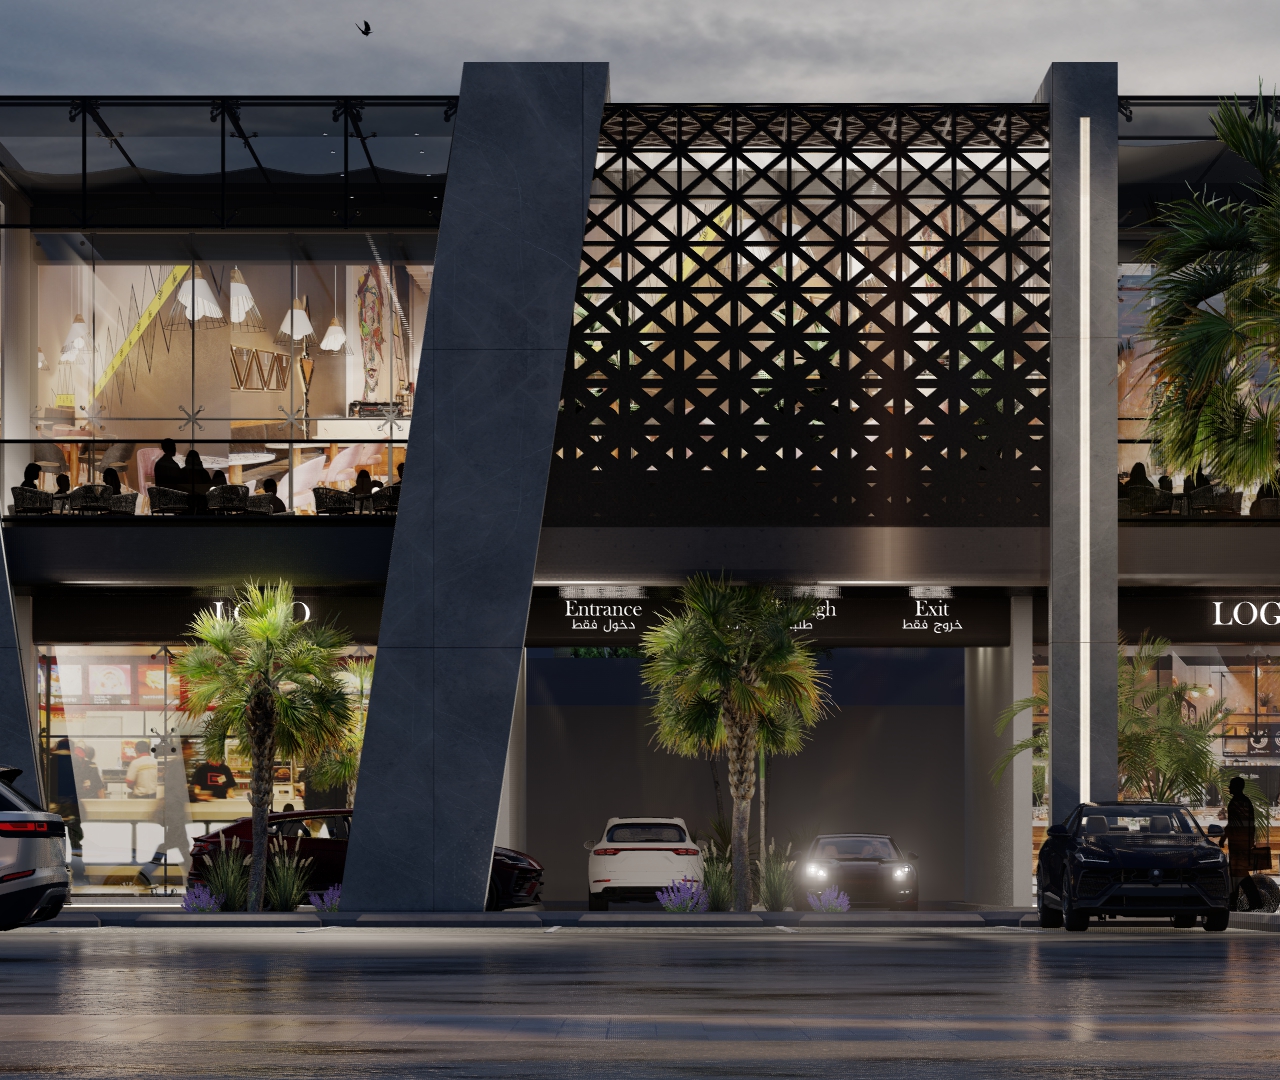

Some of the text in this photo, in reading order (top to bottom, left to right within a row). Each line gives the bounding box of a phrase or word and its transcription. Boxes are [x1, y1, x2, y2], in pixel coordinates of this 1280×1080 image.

[565, 600, 643, 617] Entrance
[915, 600, 950, 617] Exit
[571, 619, 636, 633] دخول فقط
[902, 619, 963, 634] خروج فقط
